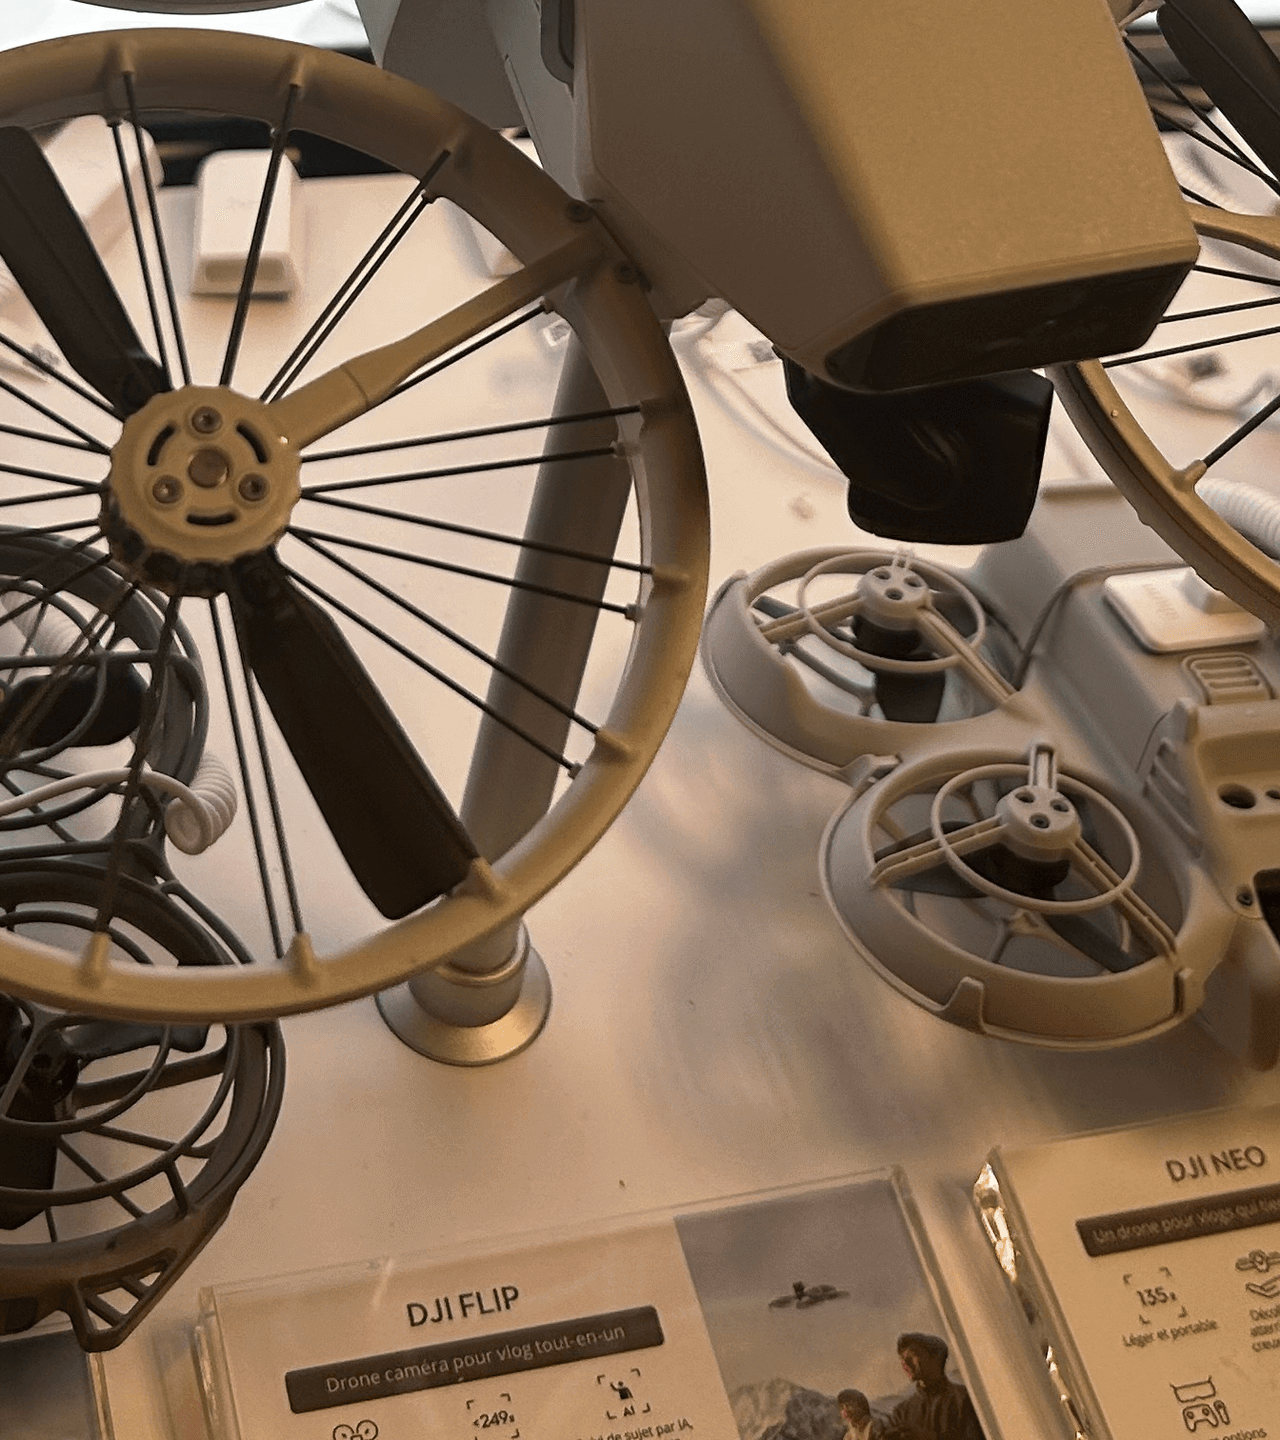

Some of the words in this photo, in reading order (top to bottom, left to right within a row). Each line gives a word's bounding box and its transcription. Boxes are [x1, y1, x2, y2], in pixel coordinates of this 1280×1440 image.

[1166, 1155, 1208, 1183] DJI
[1210, 1146, 1266, 1174] NEO
[407, 1296, 453, 1327] DJI
[459, 1285, 519, 1319] FLIP
[325, 1373, 381, 1394] Drone
[384, 1357, 449, 1384] caméra
[452, 1350, 493, 1376] pour
[494, 1340, 534, 1364] vlog
[534, 1324, 626, 1356] tout-en-un
[624, 1427, 654, 1440] sujet
[656, 1422, 675, 1437] par
